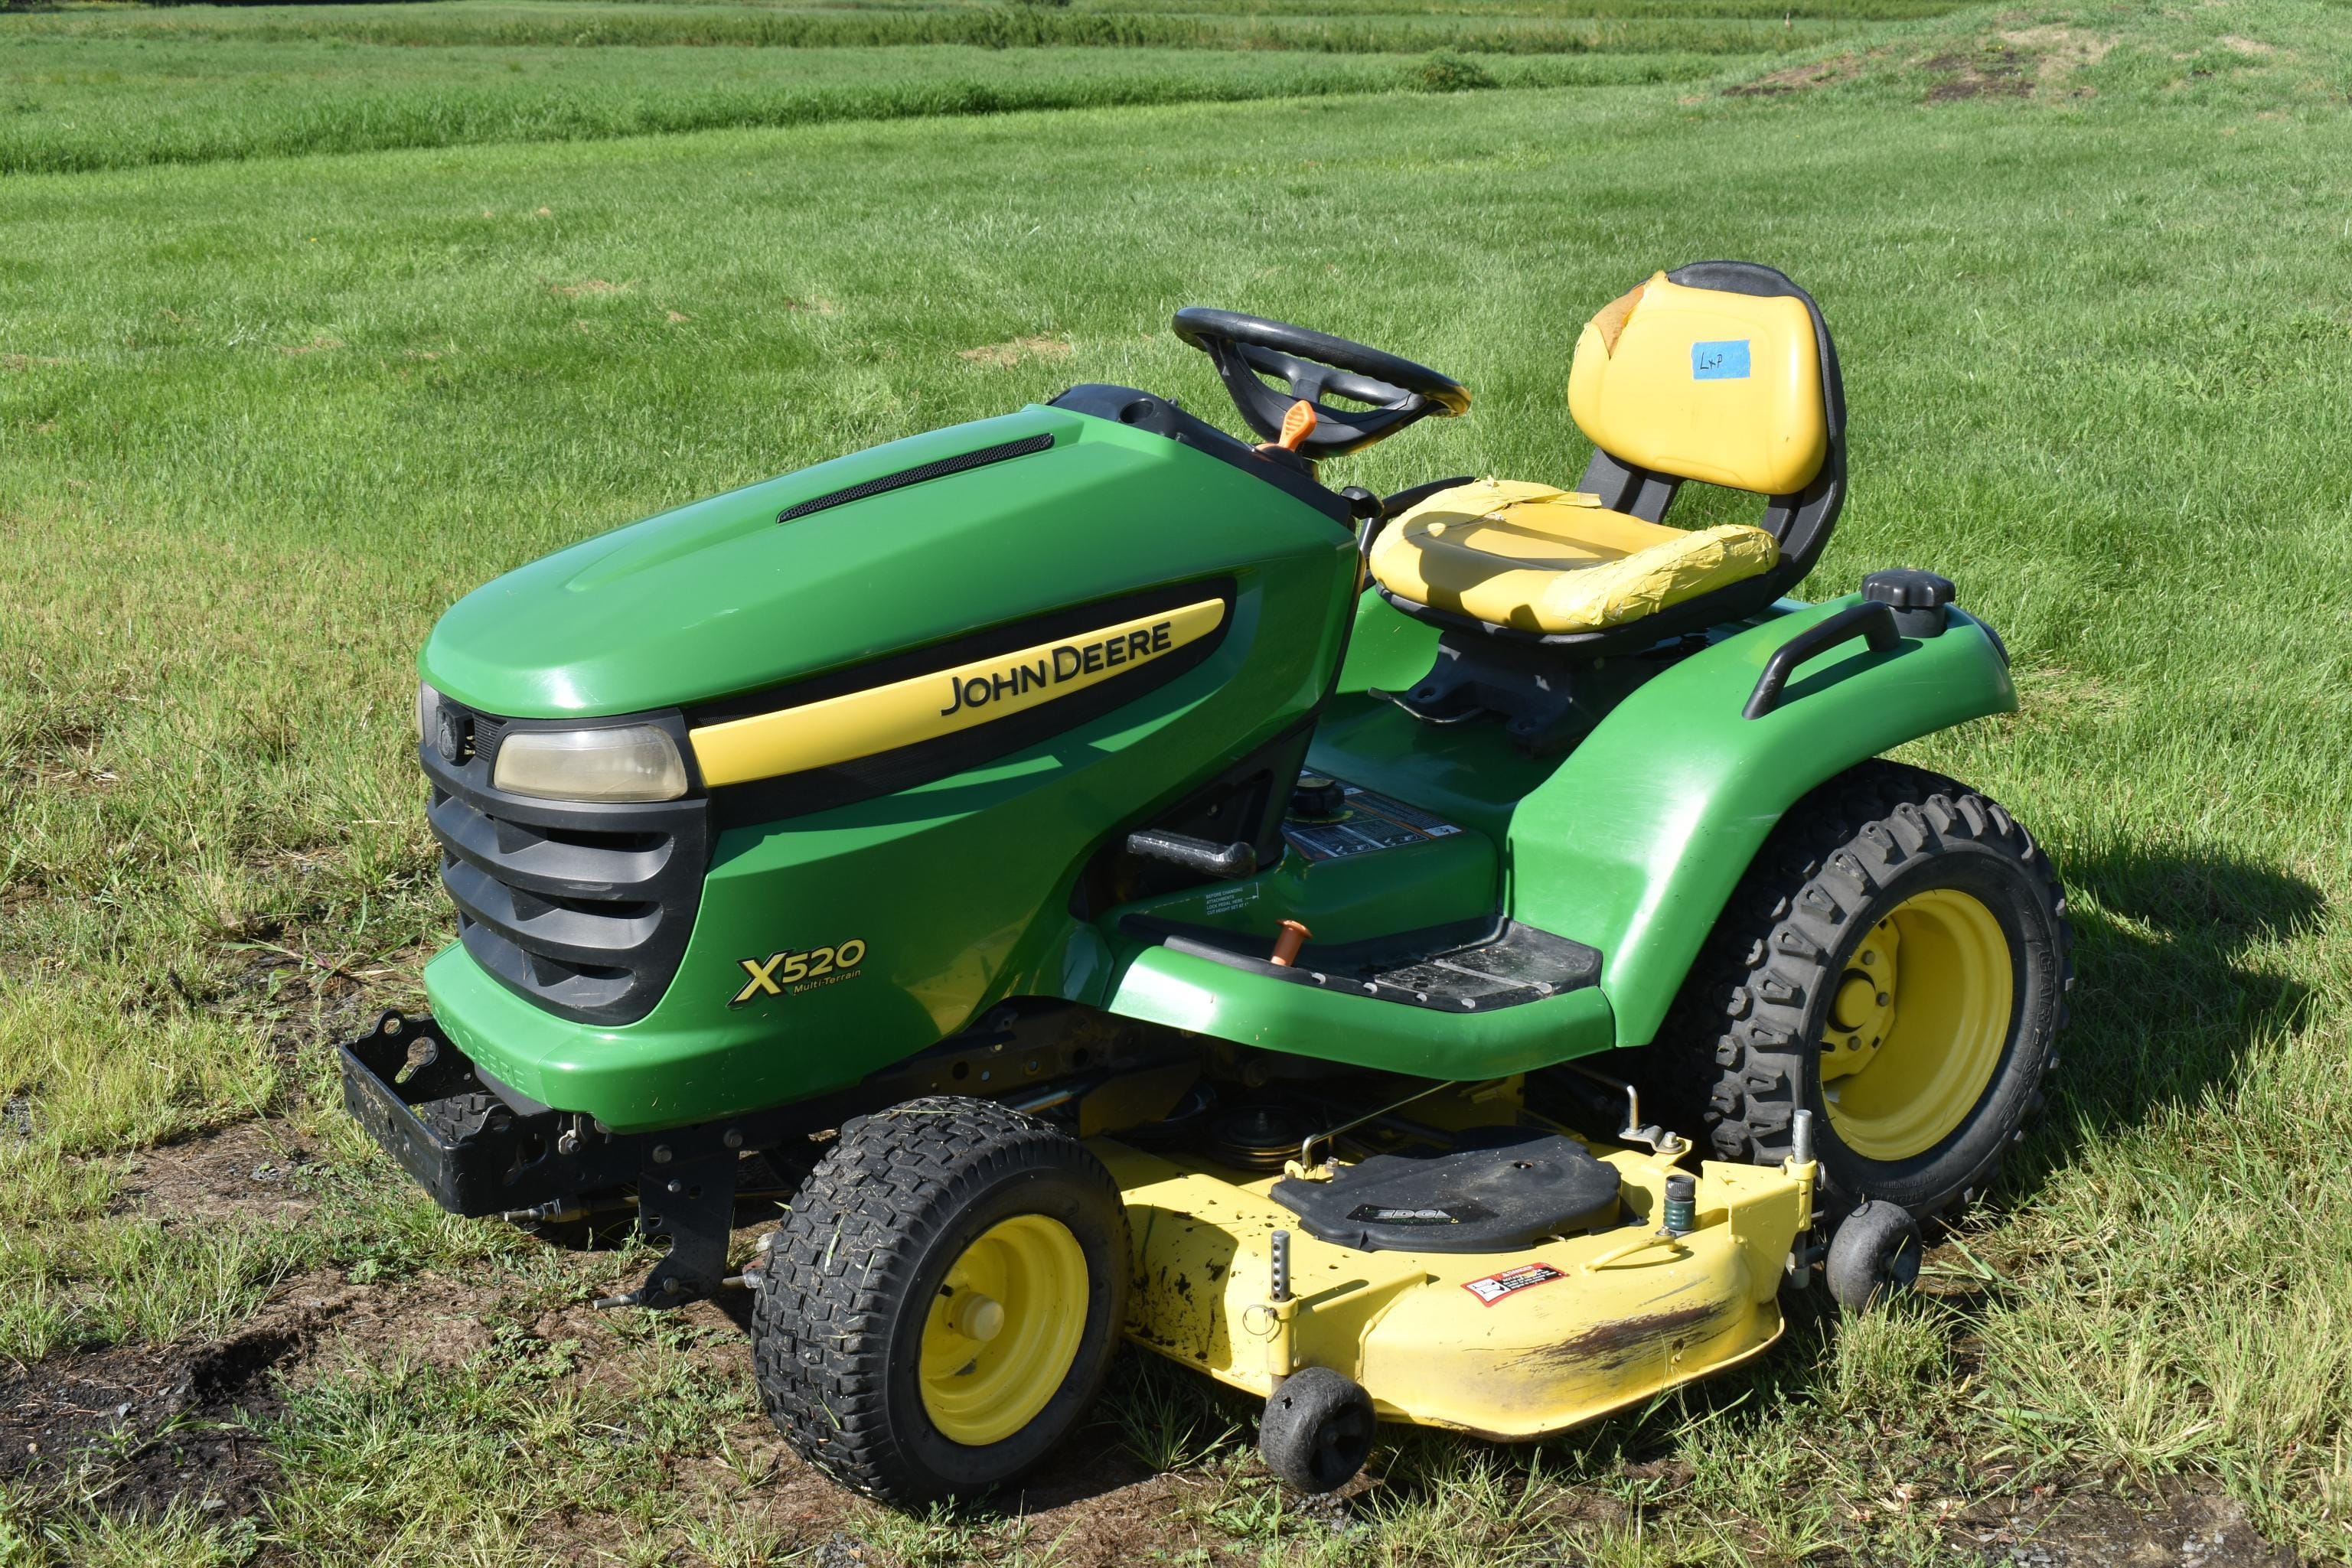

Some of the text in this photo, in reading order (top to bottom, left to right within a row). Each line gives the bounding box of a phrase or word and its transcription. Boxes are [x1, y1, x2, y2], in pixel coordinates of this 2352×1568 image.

[940, 621, 1173, 717] JOHN DEERE
[732, 938, 866, 1003] X520
[793, 969, 862, 995] Multi-Terrain
